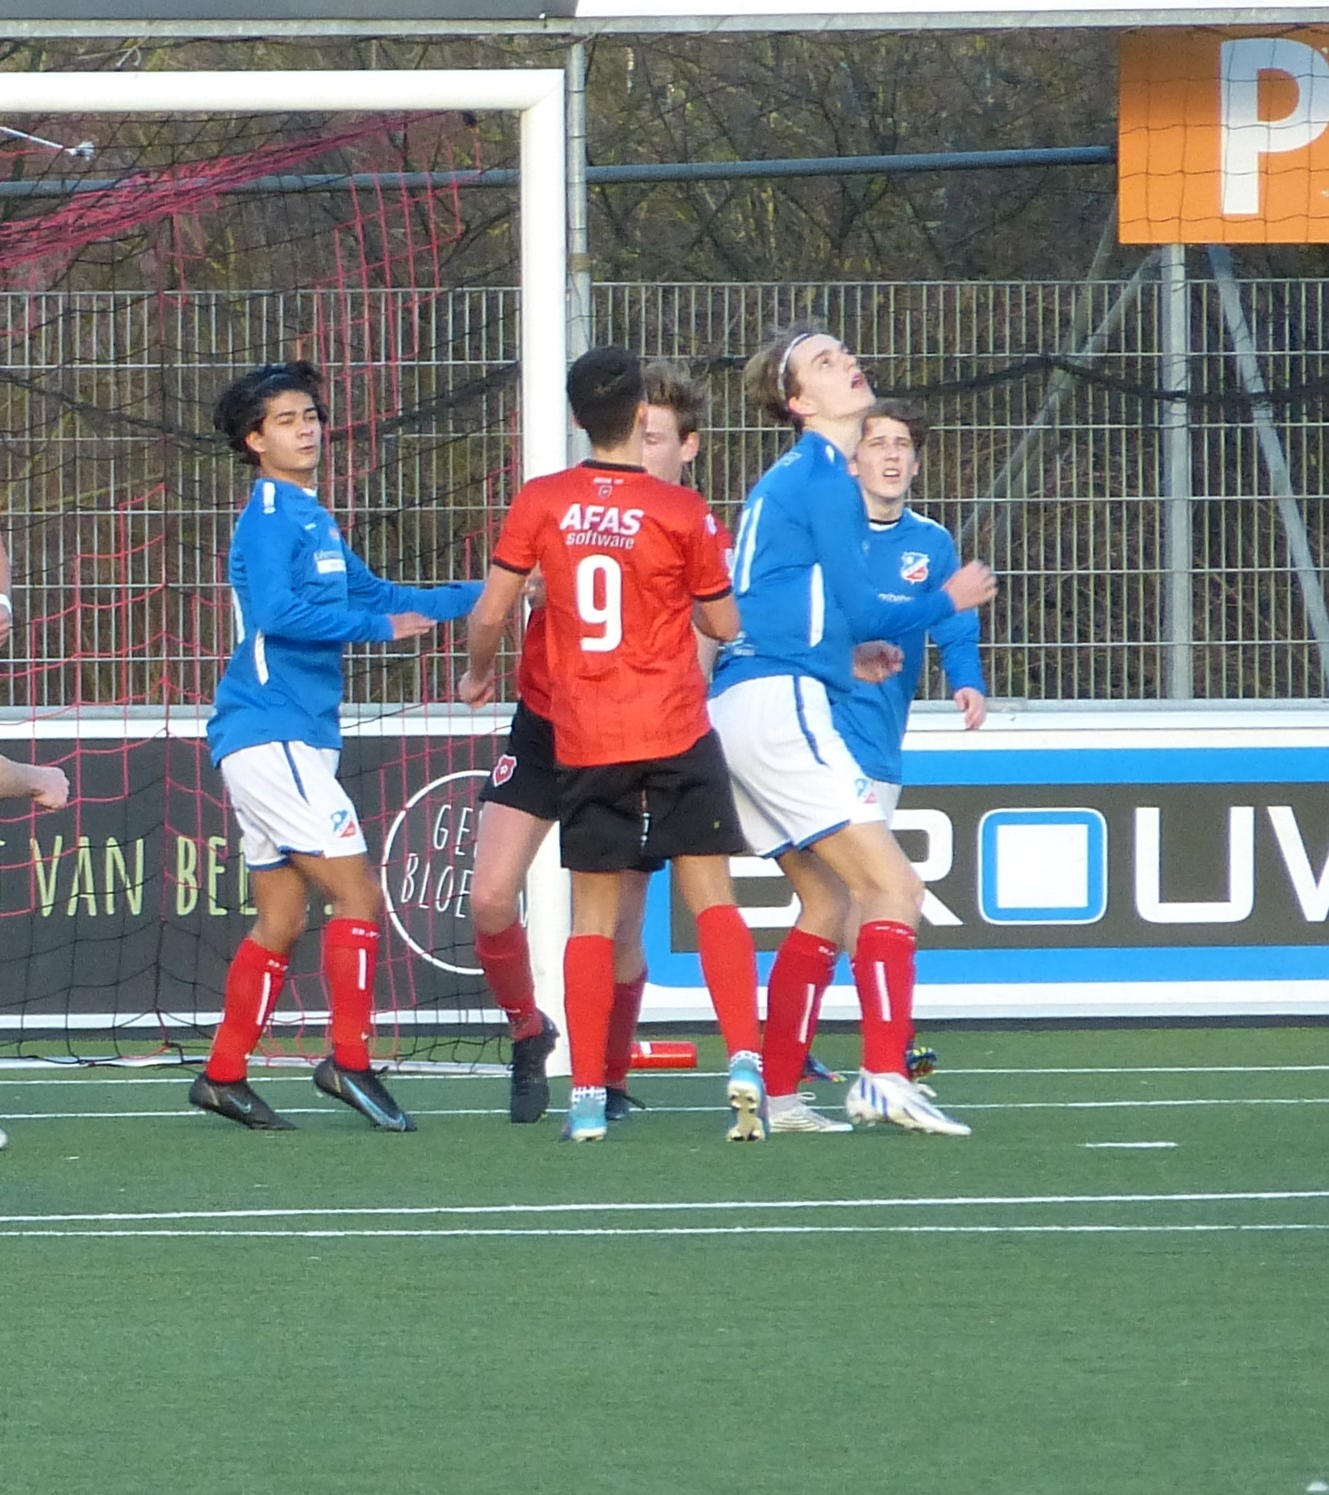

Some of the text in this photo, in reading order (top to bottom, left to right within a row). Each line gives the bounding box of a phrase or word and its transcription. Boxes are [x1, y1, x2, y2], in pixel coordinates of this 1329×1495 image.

[1221, 37, 1329, 214] P
[560, 503, 644, 535] AFAS
[566, 529, 635, 550] software
[576, 554, 623, 652] 9
[29, 835, 144, 917] VAN
[400, 853, 475, 918] BLOE
